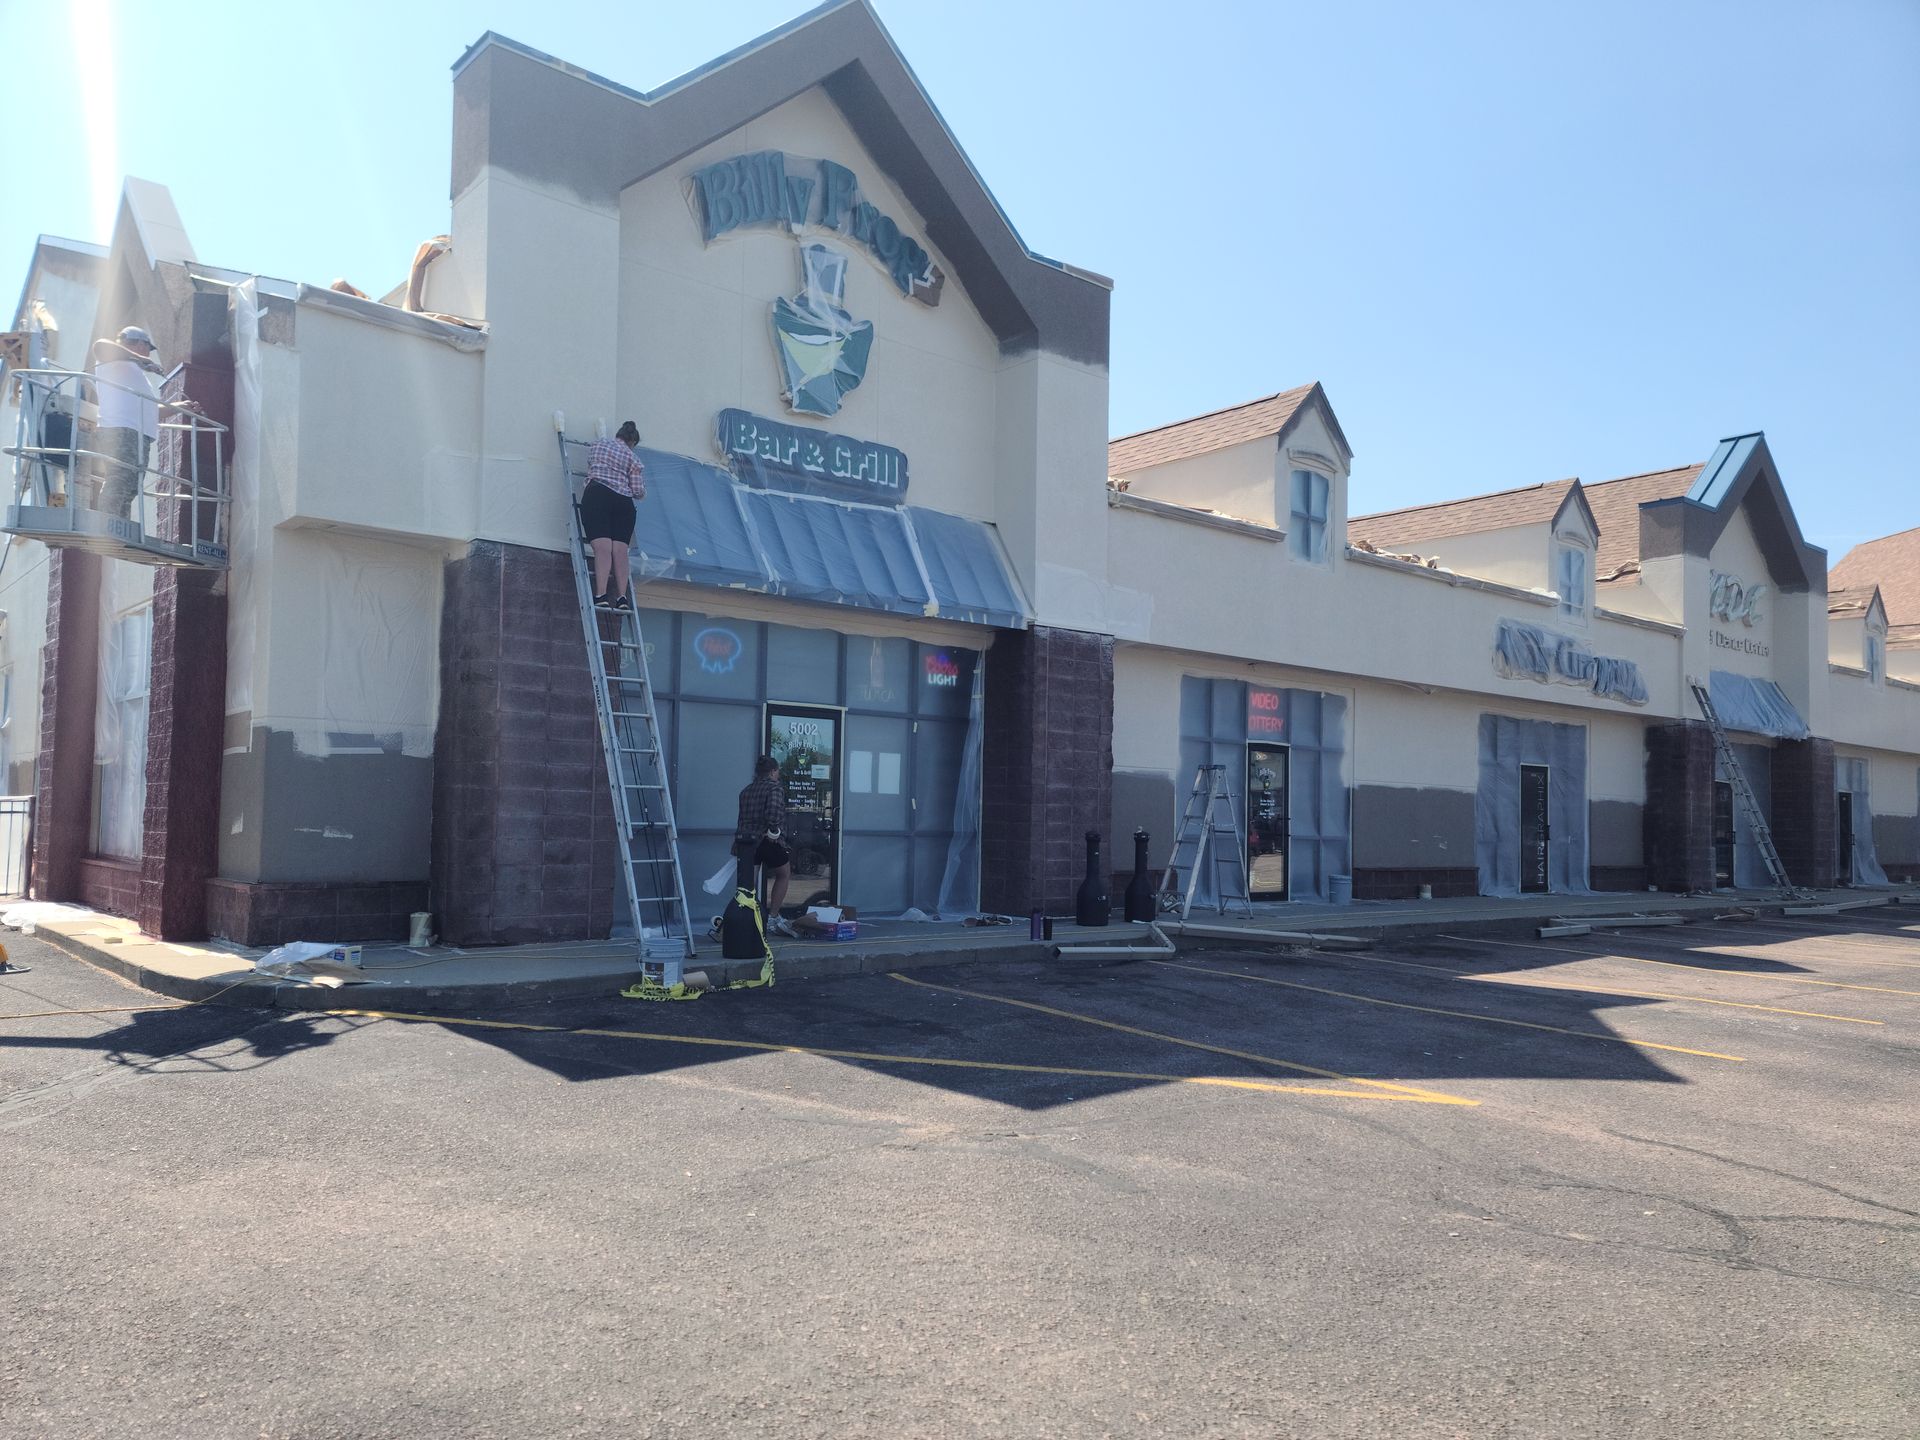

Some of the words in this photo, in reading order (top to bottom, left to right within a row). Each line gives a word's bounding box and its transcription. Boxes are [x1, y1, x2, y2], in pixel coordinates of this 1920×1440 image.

[733, 422, 799, 465] Bar
[802, 439, 826, 473] &
[830, 441, 900, 489] Grill
[927, 672, 958, 687] LIGHT
[1250, 691, 1280, 710] VIDEO
[789, 722, 818, 736] 5002
